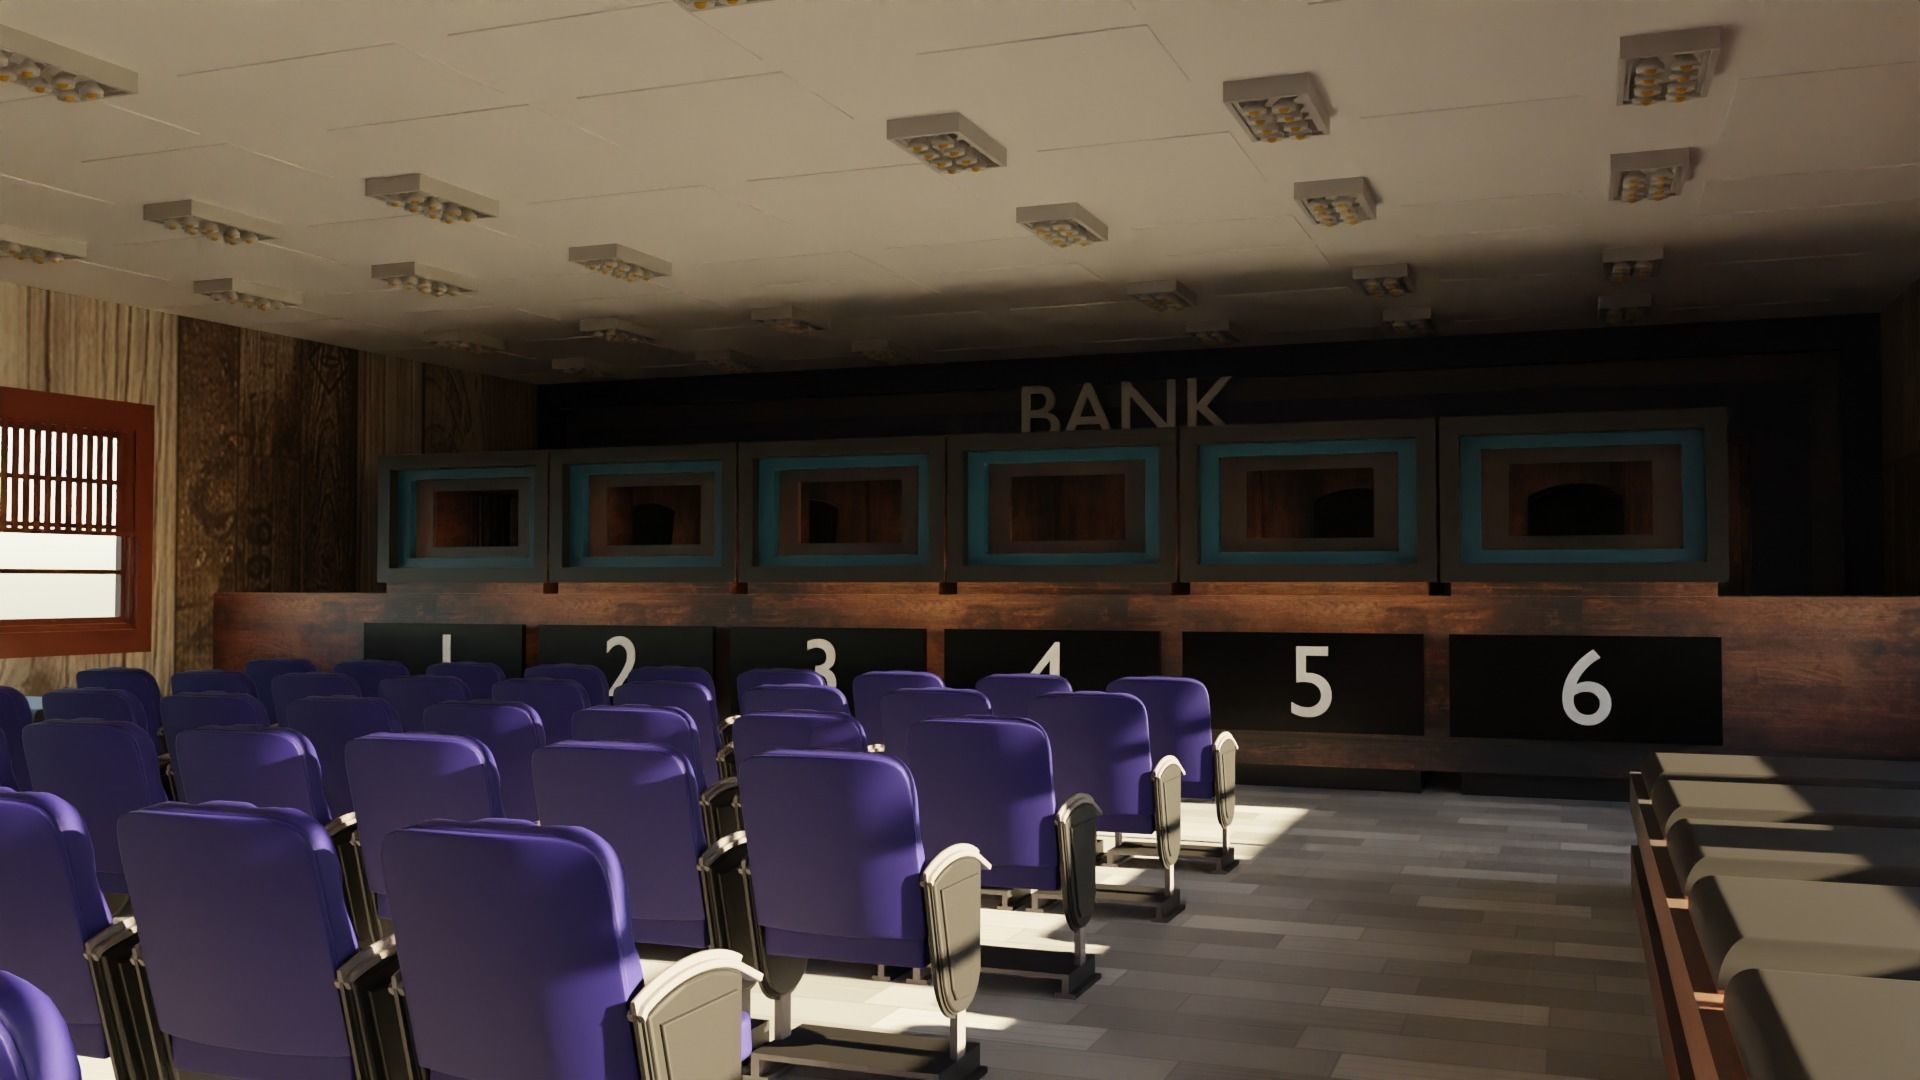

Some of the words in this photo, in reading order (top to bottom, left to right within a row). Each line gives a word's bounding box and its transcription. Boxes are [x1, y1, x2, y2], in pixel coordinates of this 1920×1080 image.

[1020, 375, 1232, 433] BANK
[606, 635, 637, 697] 2
[806, 638, 838, 689] 3
[1290, 645, 1333, 718] 5
[1561, 649, 1613, 727] 6
